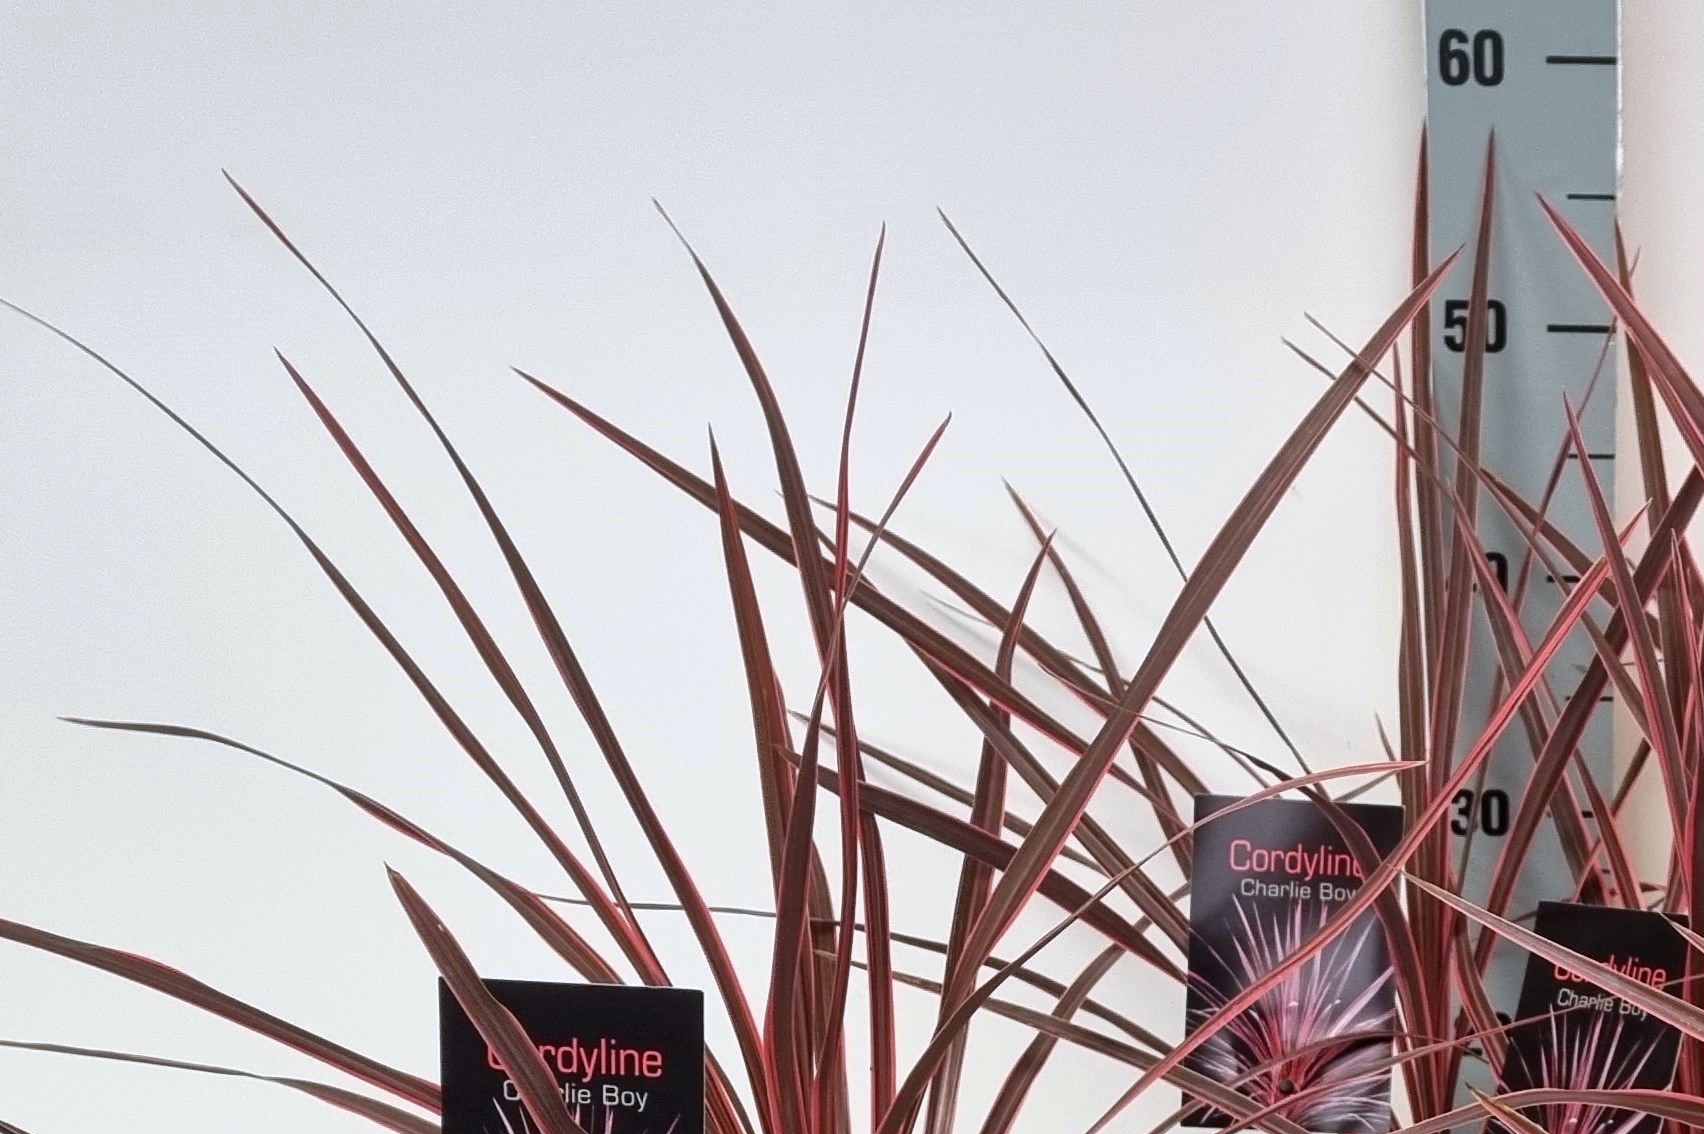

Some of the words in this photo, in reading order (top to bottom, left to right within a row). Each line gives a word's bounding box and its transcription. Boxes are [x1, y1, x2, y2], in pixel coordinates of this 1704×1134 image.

[1438, 28, 1505, 87] 60
[1443, 298, 1508, 354] 50
[1450, 788, 1510, 837] 30
[1240, 877, 1312, 900] Charlie
[1553, 953, 1667, 992] Cline
[487, 1037, 663, 1083] rdyline
[503, 1079, 592, 1104] Clie
[602, 1084, 649, 1113] Boy
